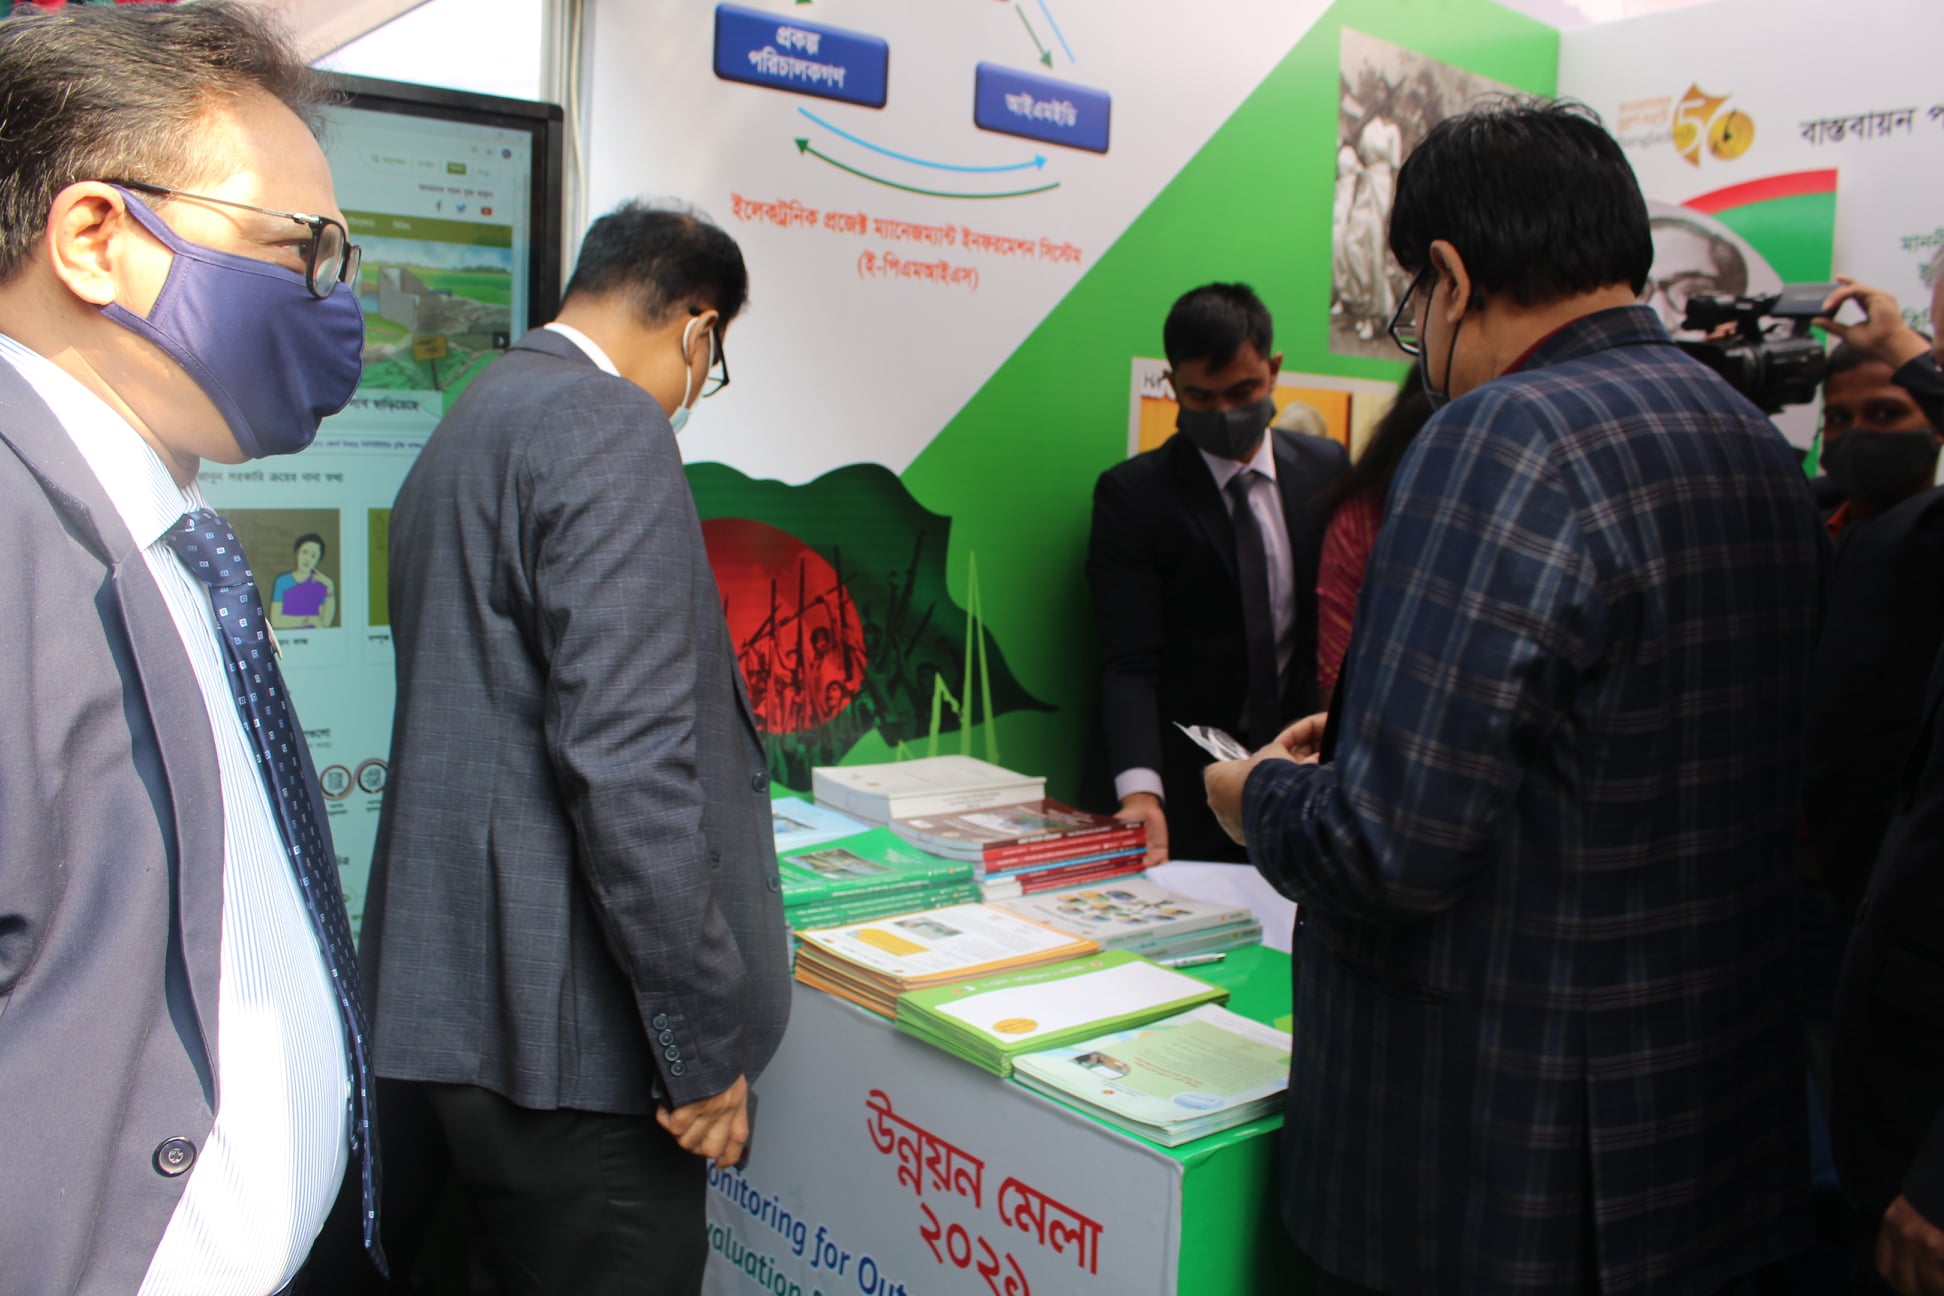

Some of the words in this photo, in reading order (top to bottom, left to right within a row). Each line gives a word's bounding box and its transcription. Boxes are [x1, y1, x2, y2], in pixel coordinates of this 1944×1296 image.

[748, 45, 846, 89] পরিচালকগণ
[1798, 106, 1918, 147] বাস্তবায়ন
[706, 1161, 807, 1257] onitoring
[811, 1226, 851, 1276] for
[866, 1089, 985, 1209] উন্নয়ন
[998, 1176, 1103, 1275] মেলা
[920, 1202, 1031, 1296] ২০২১
